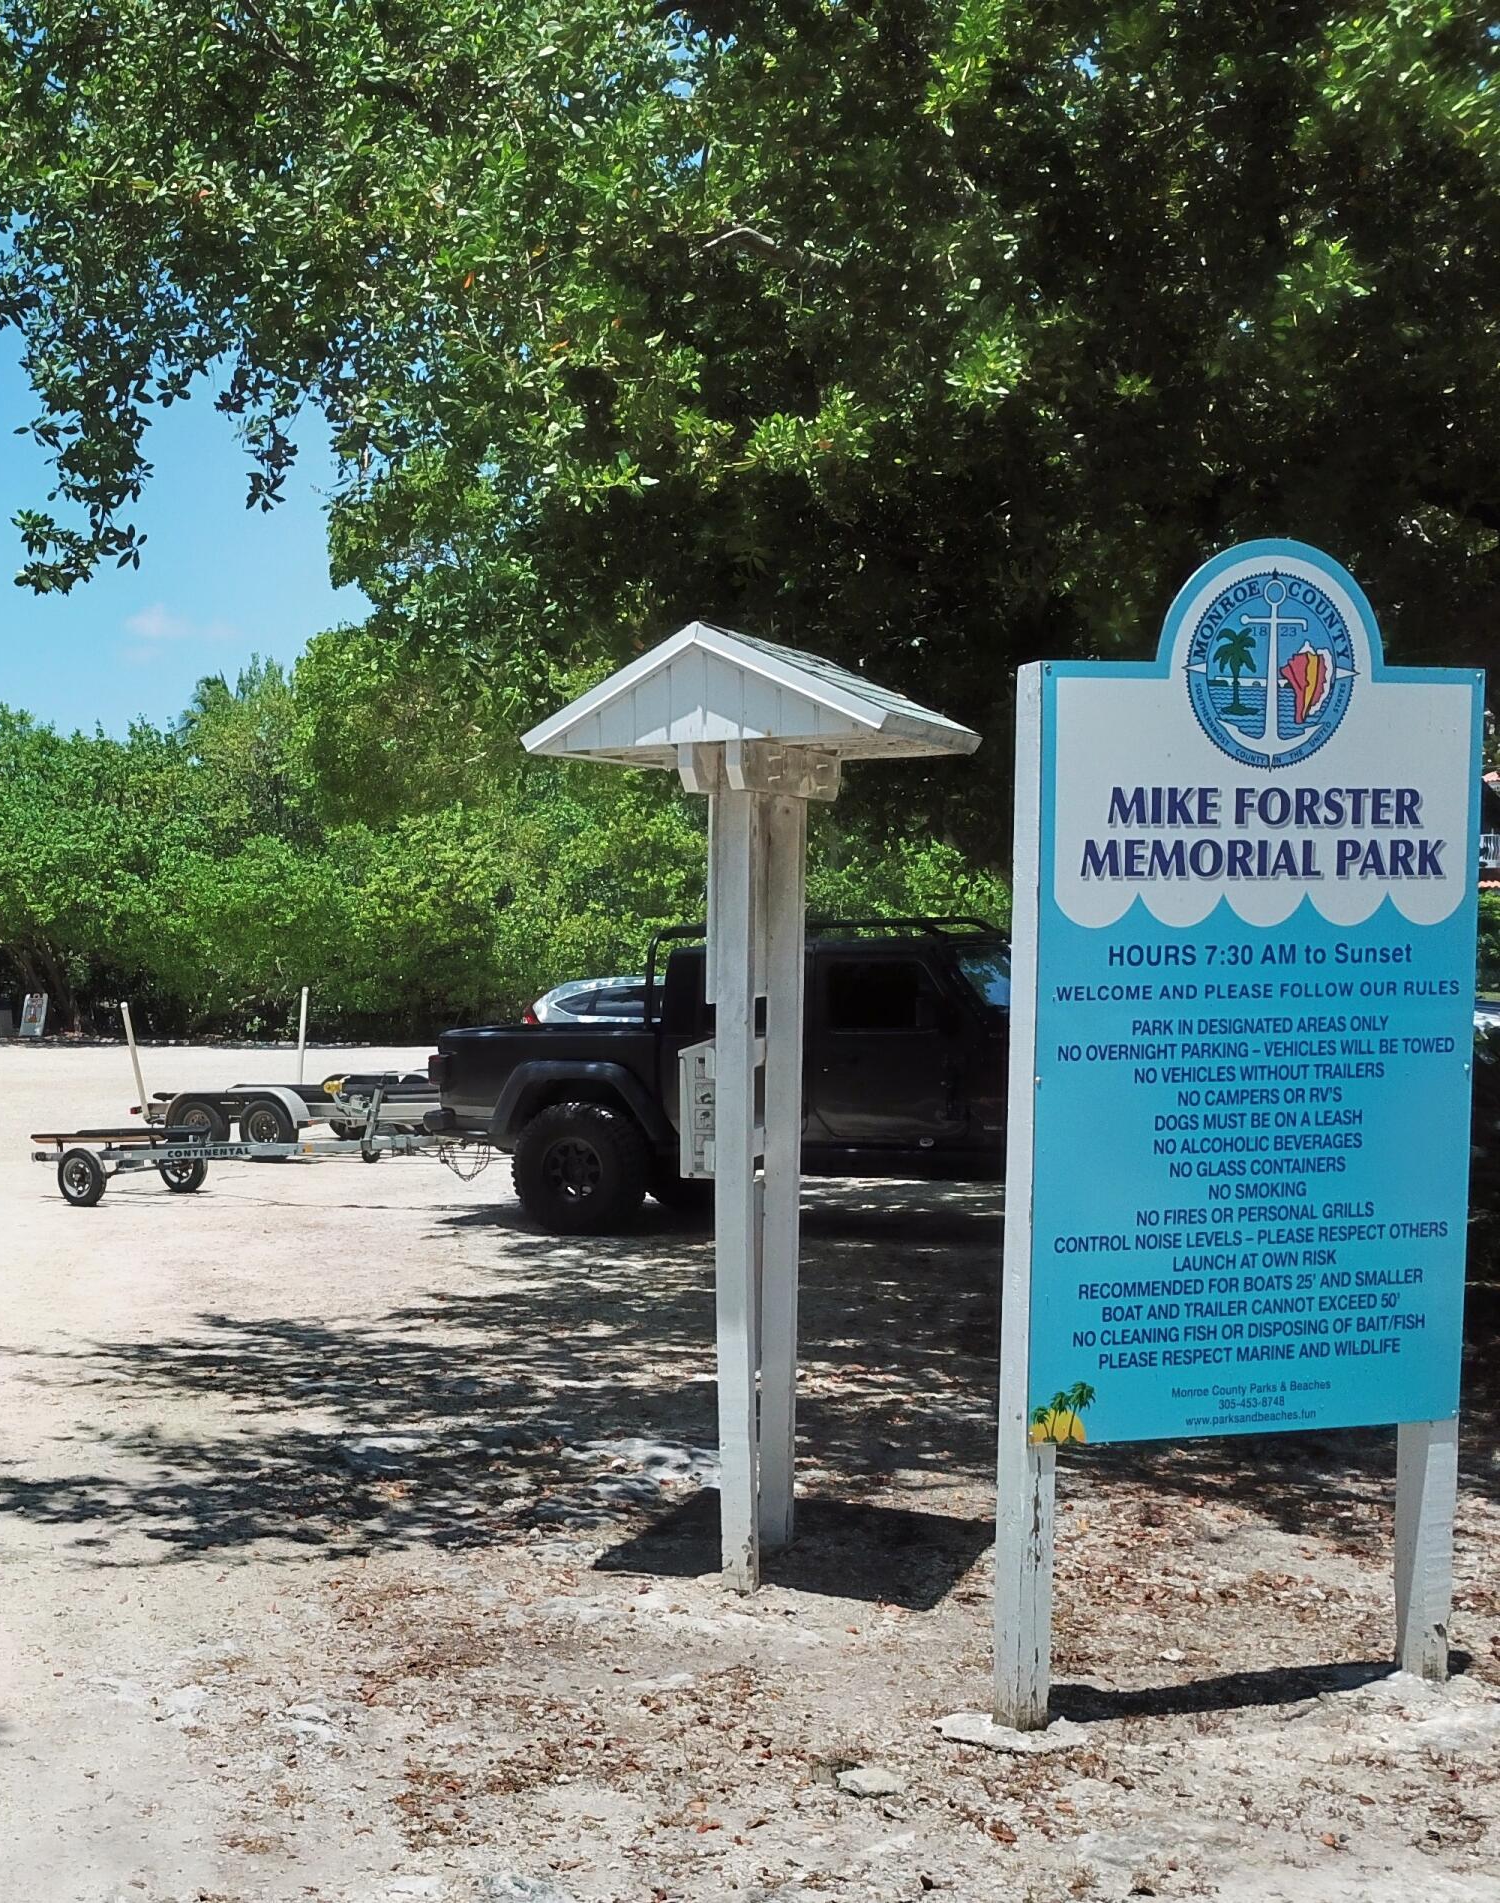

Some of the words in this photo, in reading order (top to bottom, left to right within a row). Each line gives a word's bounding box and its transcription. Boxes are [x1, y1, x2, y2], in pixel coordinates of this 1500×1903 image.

[1194, 580, 1261, 660] MONROE
[1288, 582, 1350, 660] COUNTY
[1280, 626, 1297, 637] 23
[1195, 682, 1230, 746] SOUTHERNMOST
[1236, 748, 1266, 764] COUNTY
[1274, 755, 1282, 764] IN
[1289, 748, 1304, 760] THE
[1309, 721, 1333, 749] UNITED
[1333, 682, 1346, 713] STATES
[1108, 786, 1220, 827] MIKE
[1235, 786, 1422, 827] FORSTER
[1080, 838, 1322, 878] MEMORIAL
[1336, 838, 1444, 878] PARK
[1109, 944, 1196, 967] HOURS
[1205, 945, 1253, 965] 7:30
[1260, 944, 1296, 965] AM
[1304, 945, 1326, 964] to
[1335, 943, 1412, 964] Sunset
[1056, 985, 1152, 1001] WELCOME
[1159, 984, 1197, 1000] AND
[1205, 984, 1273, 999] PLEASE
[1280, 982, 1354, 998] FOLLOW
[1360, 981, 1397, 996] OUR
[1404, 980, 1460, 995] RULES
[1132, 1019, 1173, 1036] PARK
[1178, 1019, 1193, 1035] IN
[1198, 1017, 1293, 1035] DESIGNATED
[1297, 1016, 1346, 1032] AREAS
[1350, 1016, 1389, 1032] ONLY
[1058, 1045, 1082, 1061] NO
[1086, 1043, 1177, 1061] OVERNIGHT
[1181, 1042, 1248, 1059] PARKING
[1264, 1040, 1336, 1057] VEHICLES
[1340, 1039, 1375, 1055] WILL
[1379, 1038, 1398, 1054] BE
[1402, 1037, 1454, 1054] TOWED
[1134, 1067, 1157, 1084] NO
[1161, 1066, 1236, 1083] VEHICLES
[1240, 1064, 1310, 1081] WITHOUT
[1313, 1062, 1385, 1079] TRAILERS
[1178, 1090, 1200, 1106] NO
[1204, 1088, 1280, 1106] CAMPERS
[1284, 1088, 1305, 1104] OR
[1309, 1086, 1342, 1103] RV'S
[1155, 1114, 1199, 1131] DOGS
[1203, 1113, 1247, 1129] MUST
[1251, 1112, 1270, 1128] BE
[1275, 1112, 1296, 1128] ON
[1300, 1111, 1311, 1126] A
[1315, 1109, 1362, 1126] LEASH
[168, 1147, 251, 1158] CONTINENTAL
[1154, 1138, 1177, 1155] NO
[1180, 1136, 1269, 1154] ALCOHOLIC
[1274, 1132, 1362, 1151] BEVERAGES
[1170, 1162, 1192, 1178] NO
[1196, 1160, 1247, 1177] GLASS
[1250, 1156, 1346, 1175] CONTAINERS
[1209, 1184, 1231, 1200] NO
[1235, 1181, 1307, 1199] SMOKING
[1137, 1210, 1159, 1226] NO
[1164, 1208, 1207, 1225] FIRES
[1211, 1207, 1233, 1224] OR
[1238, 1204, 1318, 1223] PERSONAL
[1322, 1201, 1374, 1219] GRILLS
[1054, 1235, 1131, 1253] CONTROL
[1135, 1233, 1182, 1250] NOISE
[1186, 1230, 1242, 1248] LEVELS
[1258, 1227, 1314, 1245] PLEASE
[1319, 1224, 1386, 1242] RESPECT
[1389, 1221, 1448, 1239] OTHERS
[1173, 1254, 1236, 1272] LAUNCH
[1240, 1253, 1259, 1269] AT
[1262, 1252, 1298, 1268] OWN
[1303, 1249, 1337, 1265] RISK
[1079, 1279, 1204, 1299] RECOMMENDED
[1209, 1277, 1239, 1293] FOR
[1244, 1275, 1292, 1292] BOATS
[1296, 1274, 1316, 1289] 25'
[1320, 1272, 1351, 1288] AND
[1355, 1268, 1423, 1287] SMALLER
[1102, 1305, 1143, 1322] BOAT
[1147, 1304, 1180, 1320] AND
[1184, 1300, 1247, 1318] TRAILER
[1252, 1296, 1315, 1315] CANNOT
[1319, 1294, 1377, 1311] EXCEED
[1381, 1292, 1400, 1308] 50'
[1073, 1331, 1096, 1347] NO
[1100, 1327, 1179, 1346] CLEANING
[1184, 1325, 1217, 1341] FISH
[1222, 1324, 1244, 1340] OR
[1248, 1319, 1328, 1338] DISPOSING
[1333, 1318, 1352, 1334] OF
[1357, 1313, 1425, 1332] BAIT/FISH
[1099, 1351, 1158, 1370] PLEASE
[1162, 1347, 1232, 1366] RESPECT
[1237, 1344, 1295, 1362] MARINE
[1299, 1342, 1330, 1359] AND
[1334, 1338, 1401, 1356] WILDLIFE
[1172, 1388, 1209, 1398] Monroe
[1212, 1385, 1247, 1396] County
[1250, 1383, 1277, 1393] Parks
[1280, 1381, 1286, 1391] &
[1290, 1380, 1331, 1391] Beaches
[1219, 1396, 1284, 1409] 305-453-8748
[1186, 1409, 1316, 1426] www.parksandbeaches.fun
